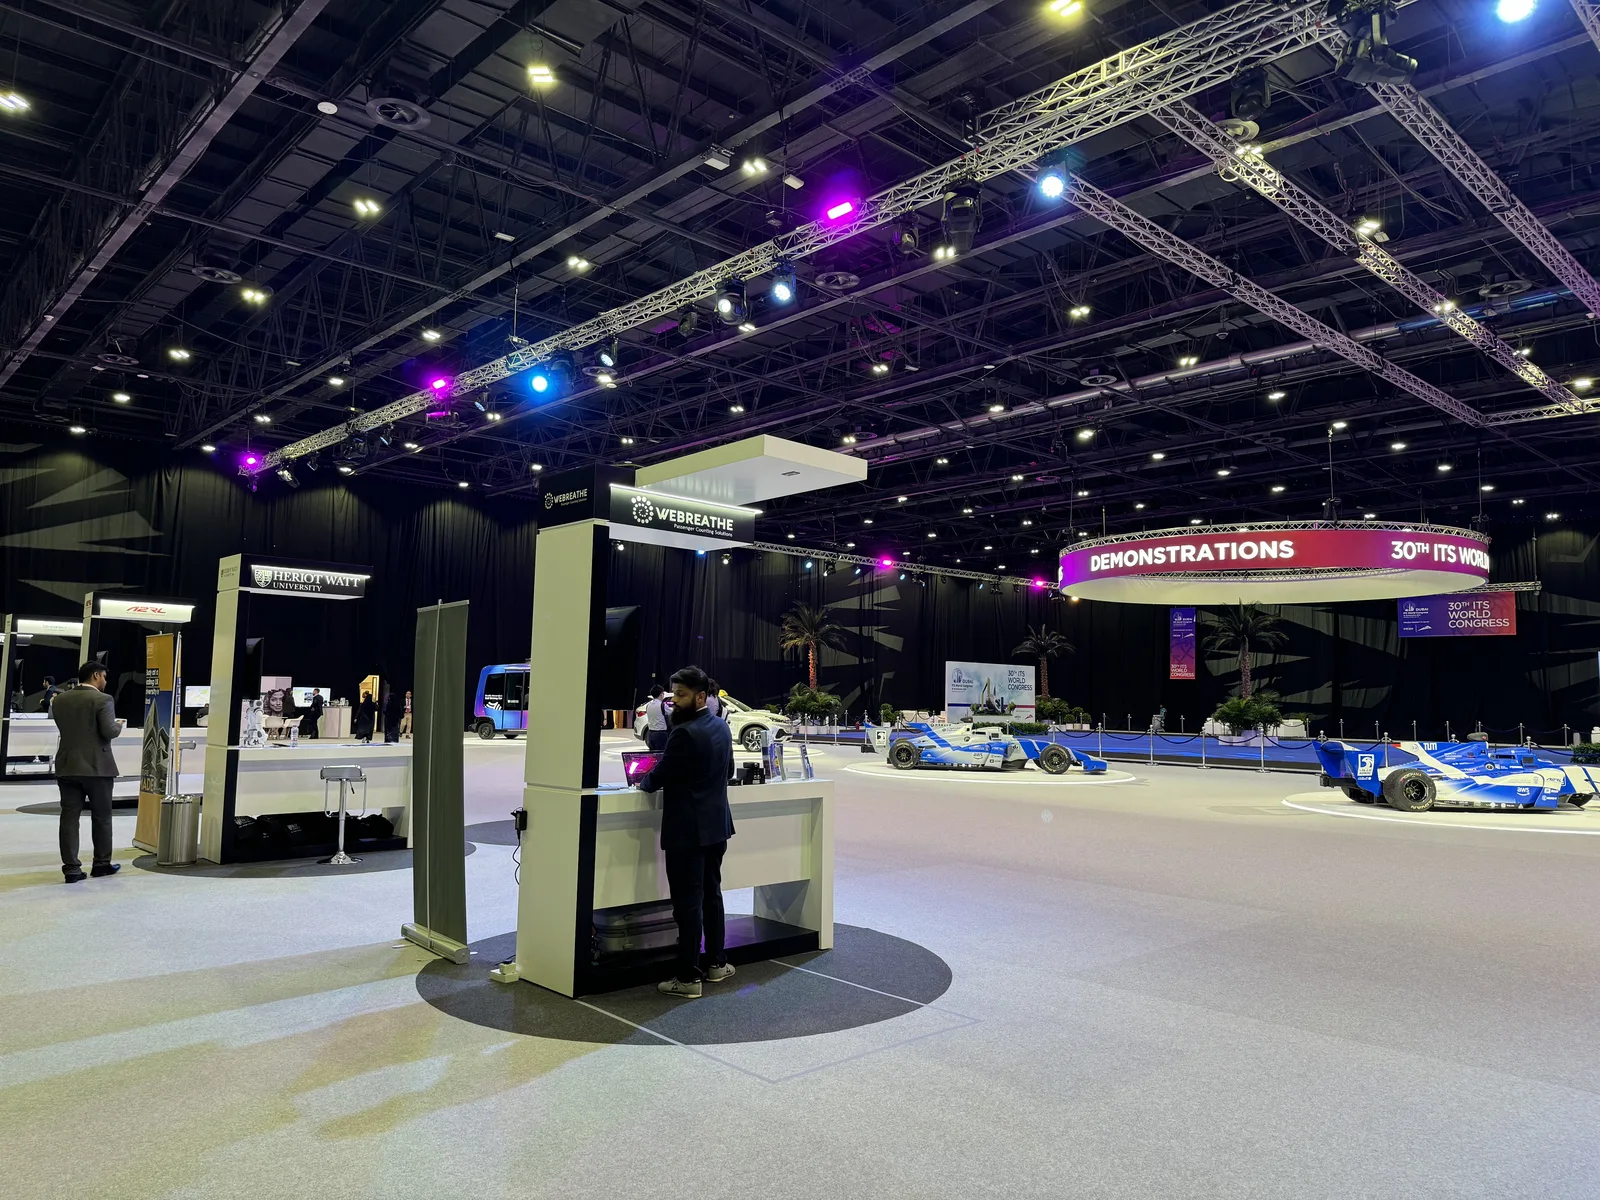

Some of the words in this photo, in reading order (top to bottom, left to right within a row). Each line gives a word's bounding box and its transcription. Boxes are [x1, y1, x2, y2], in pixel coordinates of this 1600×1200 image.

[554, 488, 588, 503] WEBREATHE
[656, 506, 734, 531] WEBREATHE
[673, 523, 695, 532] Passenger
[695, 526, 714, 535] Counting
[714, 529, 733, 537] Solutions
[1090, 540, 1294, 572] DEMONSTRATIONS
[1391, 540, 1430, 560] 30TH
[1433, 543, 1457, 563] ITS
[273, 570, 323, 584] HERIOT
[325, 575, 361, 588] WATT
[273, 582, 322, 592] UNIVERSITY
[1448, 602, 1470, 611] 30TH
[1472, 601, 1490, 609] ITS
[1448, 610, 1491, 619] WORLD
[1448, 618, 1510, 628] CONGRESS
[1008, 683, 1033, 691] CONGRESS
